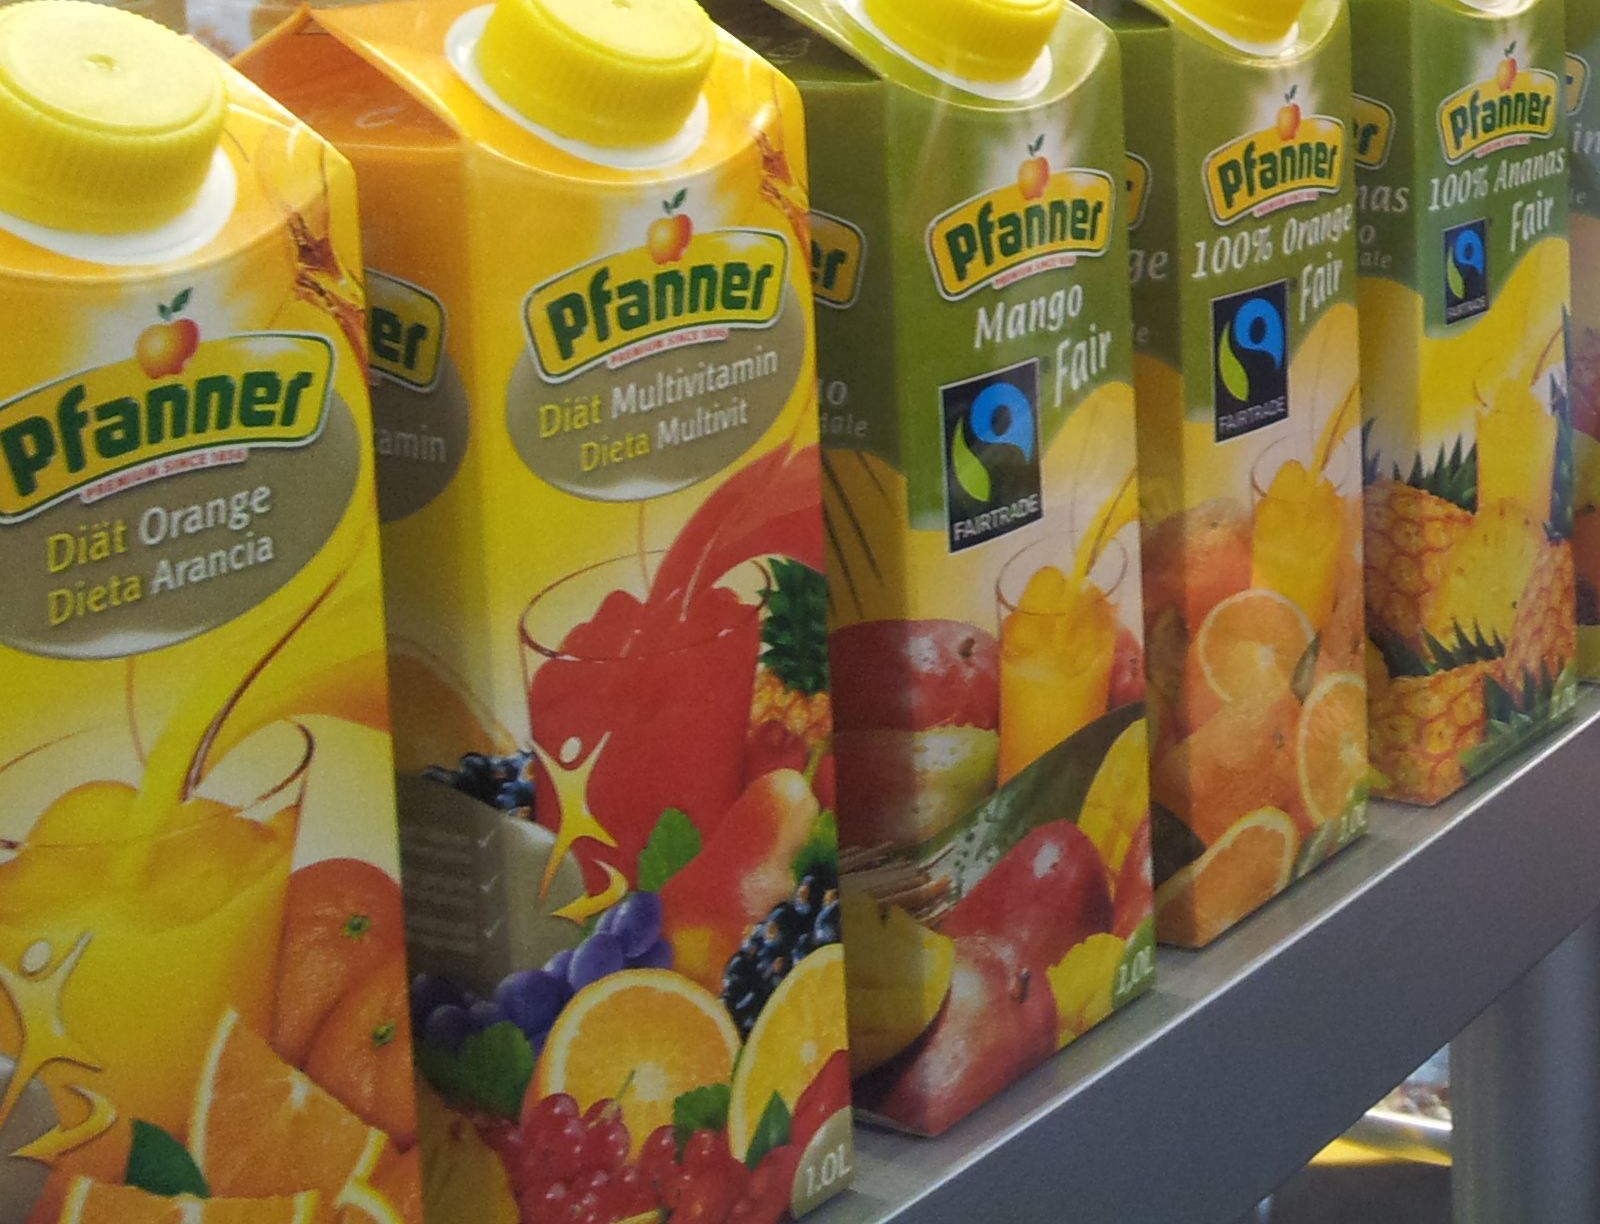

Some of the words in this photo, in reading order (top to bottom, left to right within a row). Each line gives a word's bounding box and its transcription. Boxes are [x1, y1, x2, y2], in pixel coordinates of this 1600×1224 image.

[1427, 164, 1490, 212] 100%
[1492, 147, 1567, 193] Ananas
[1191, 223, 1274, 281] 100%
[1281, 199, 1353, 257] Orange
[972, 283, 1084, 350] Mango
[537, 395, 602, 440] Diät
[610, 345, 778, 420] Multivitamin
[579, 426, 651, 472] Dieta
[656, 397, 749, 450] Multivit
[46, 519, 128, 573] Diät
[139, 484, 272, 546] Orange
[953, 493, 1040, 541] FAIRTRADE
[47, 576, 143, 627] Dieta
[151, 531, 274, 595] Arancia
